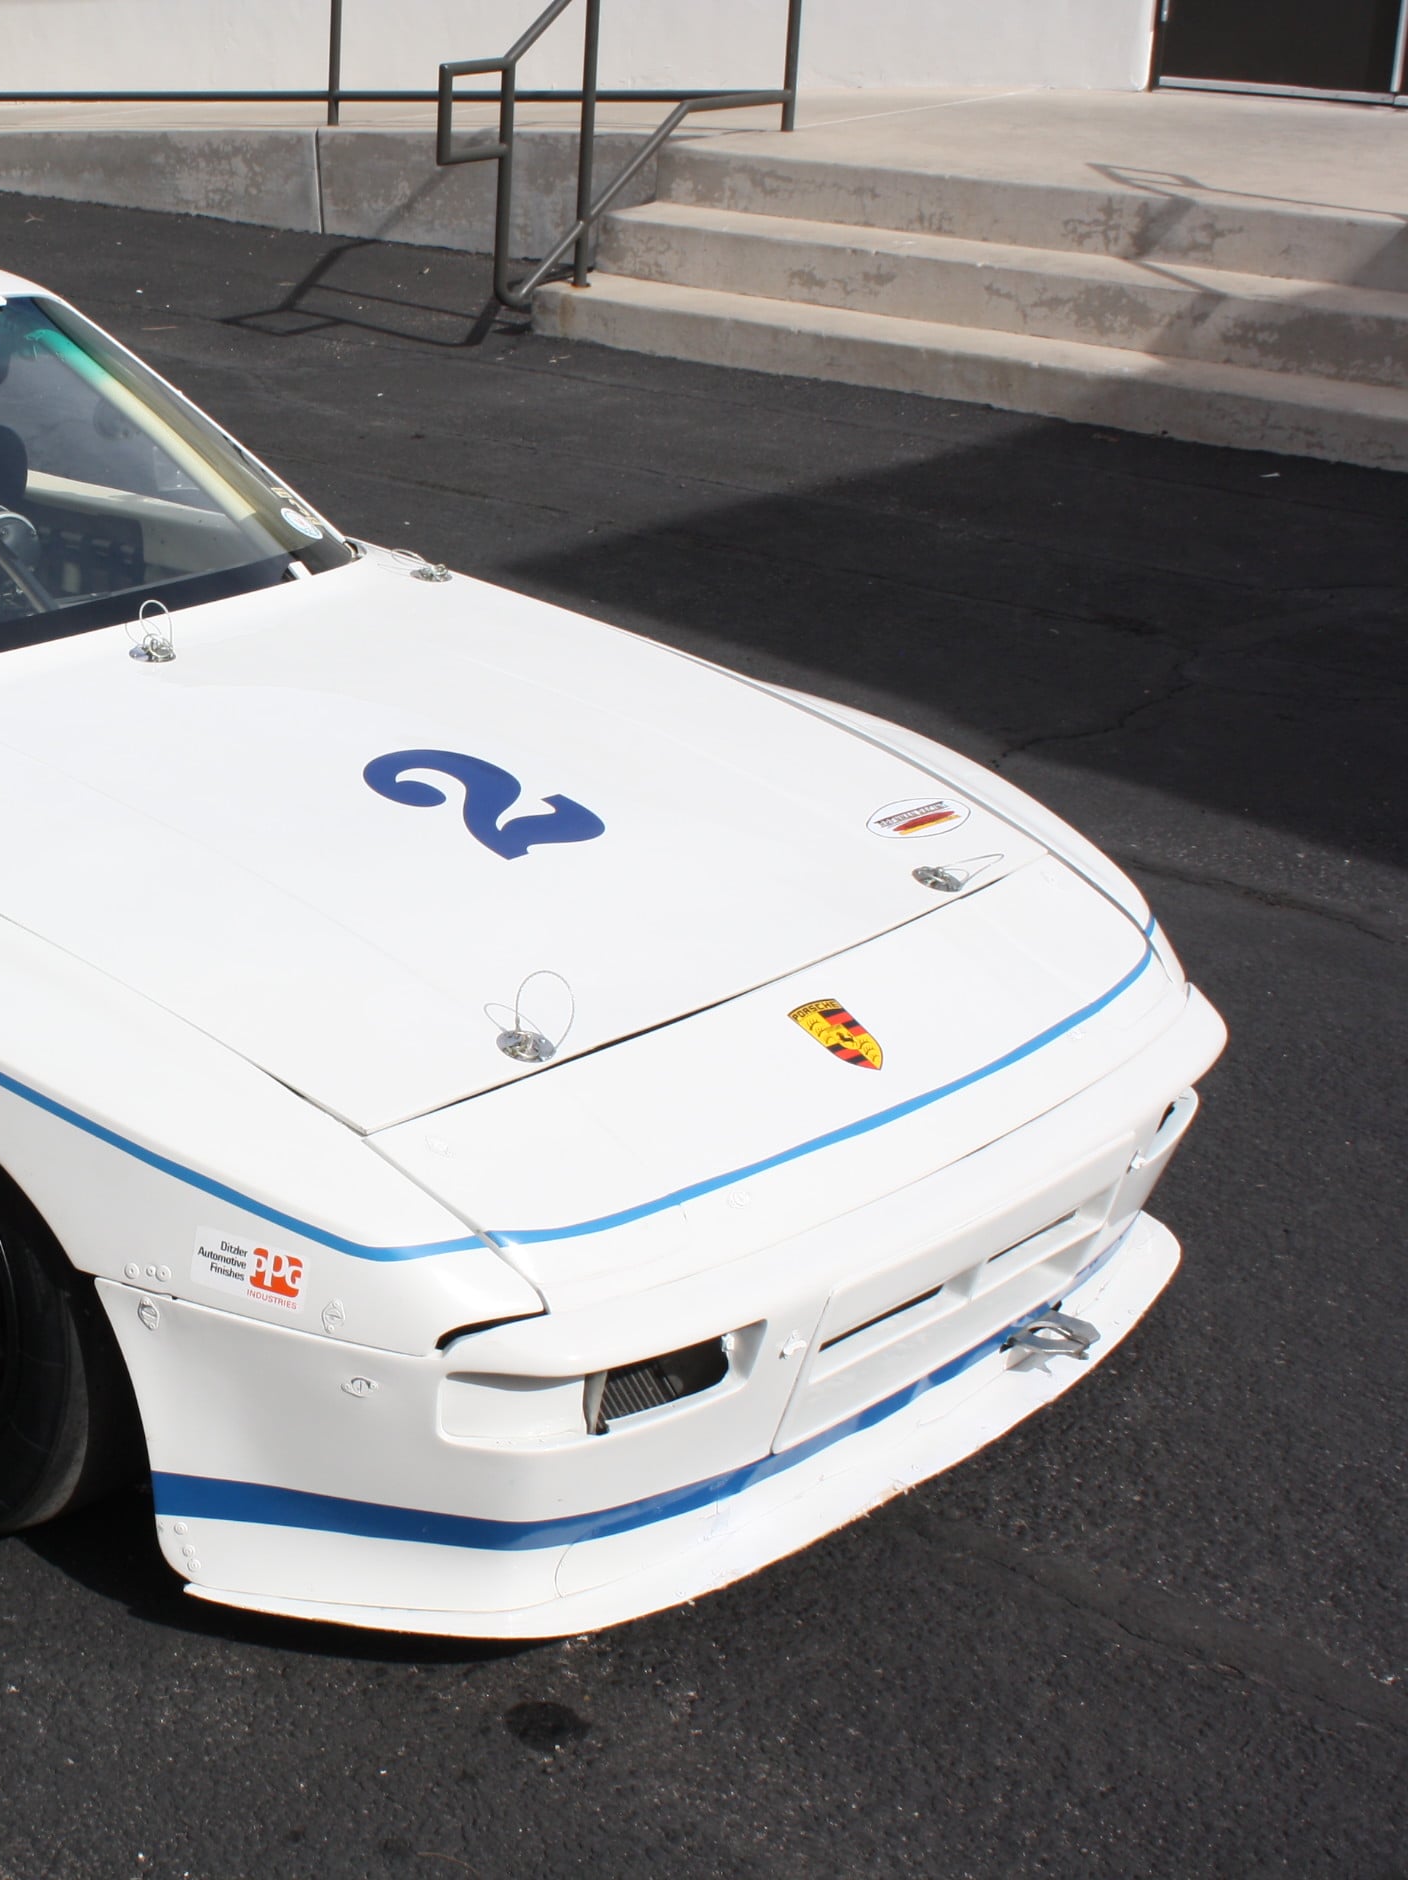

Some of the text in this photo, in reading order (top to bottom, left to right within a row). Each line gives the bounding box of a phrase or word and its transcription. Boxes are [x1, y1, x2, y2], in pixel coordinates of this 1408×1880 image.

[363, 749, 606, 860] 2
[792, 1001, 839, 1020] PORSCHE
[197, 1246, 247, 1269] Automotive
[220, 1240, 248, 1258] Ditzler
[209, 1262, 245, 1281] Finishes
[246, 1288, 297, 1310] INDUSTRIES
